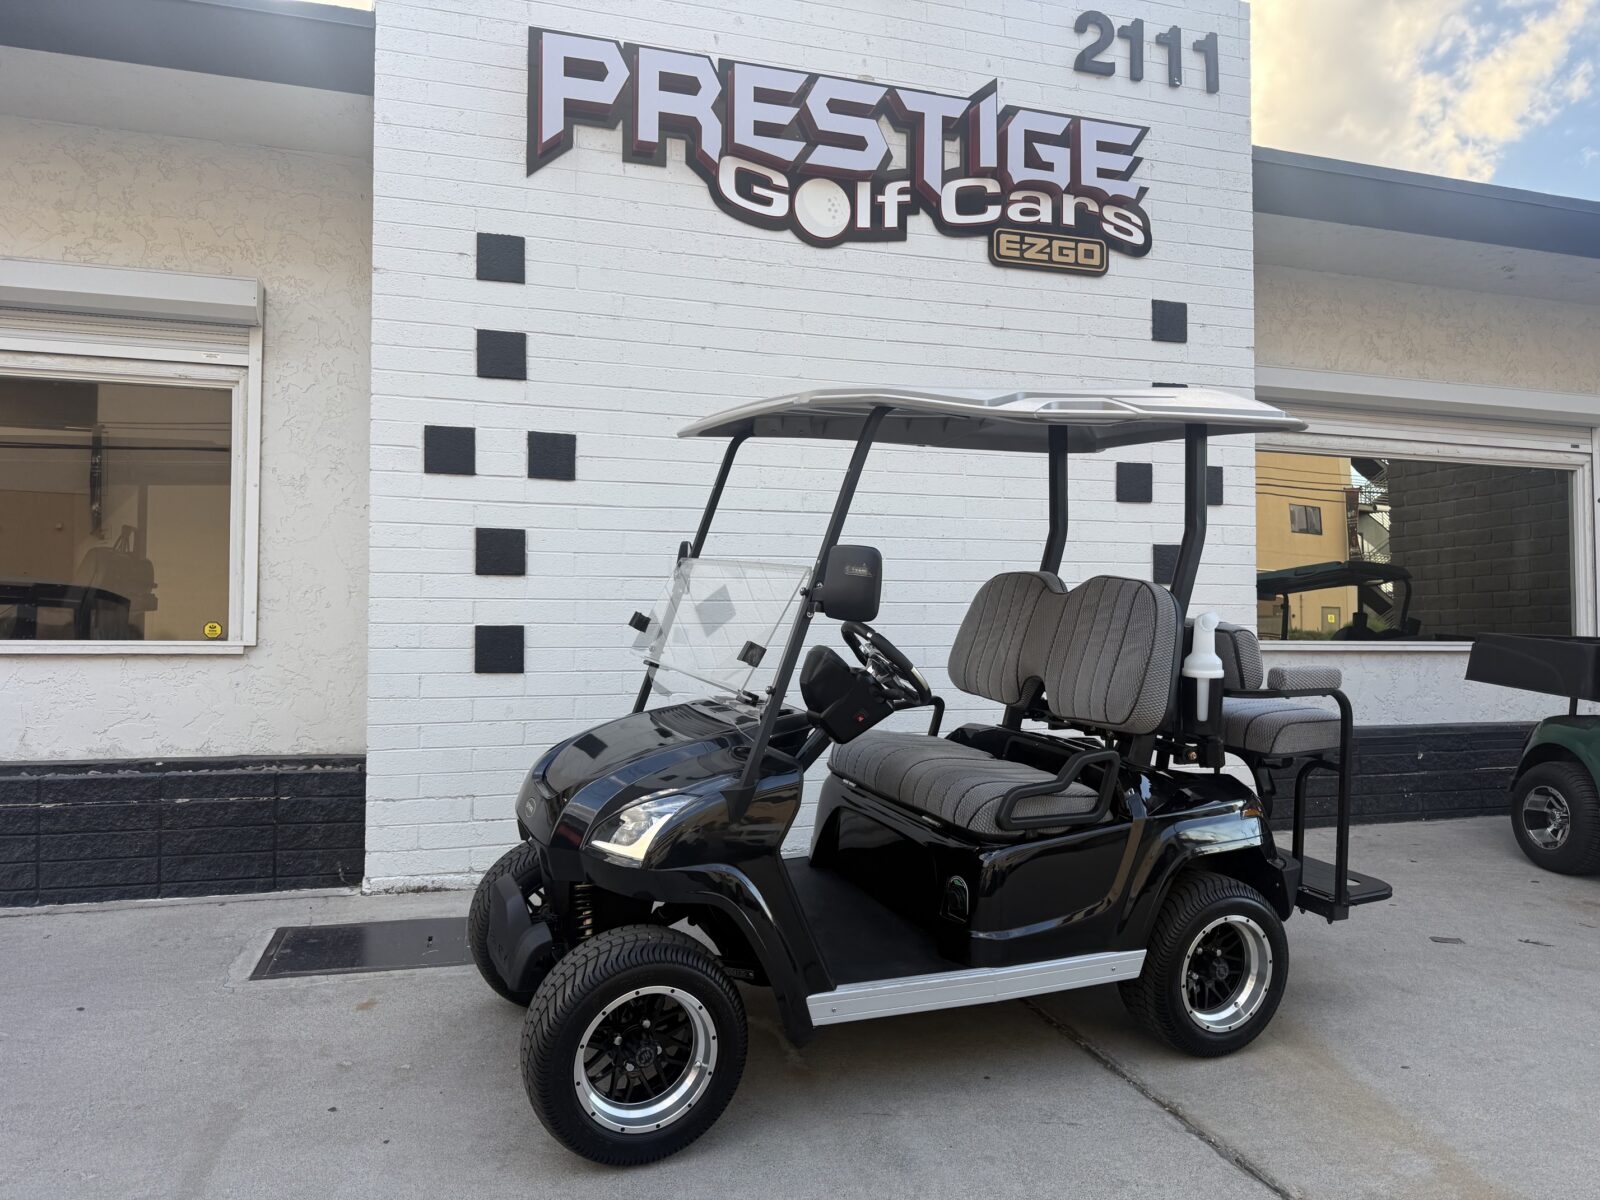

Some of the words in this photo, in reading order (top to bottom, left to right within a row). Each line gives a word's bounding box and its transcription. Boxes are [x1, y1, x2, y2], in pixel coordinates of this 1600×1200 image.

[1074, 10, 1219, 93] 2111
[540, 31, 1144, 199] PRESTIGE
[718, 155, 911, 239] Golf
[940, 177, 1145, 245] Cars
[999, 233, 1101, 266] EZGO
